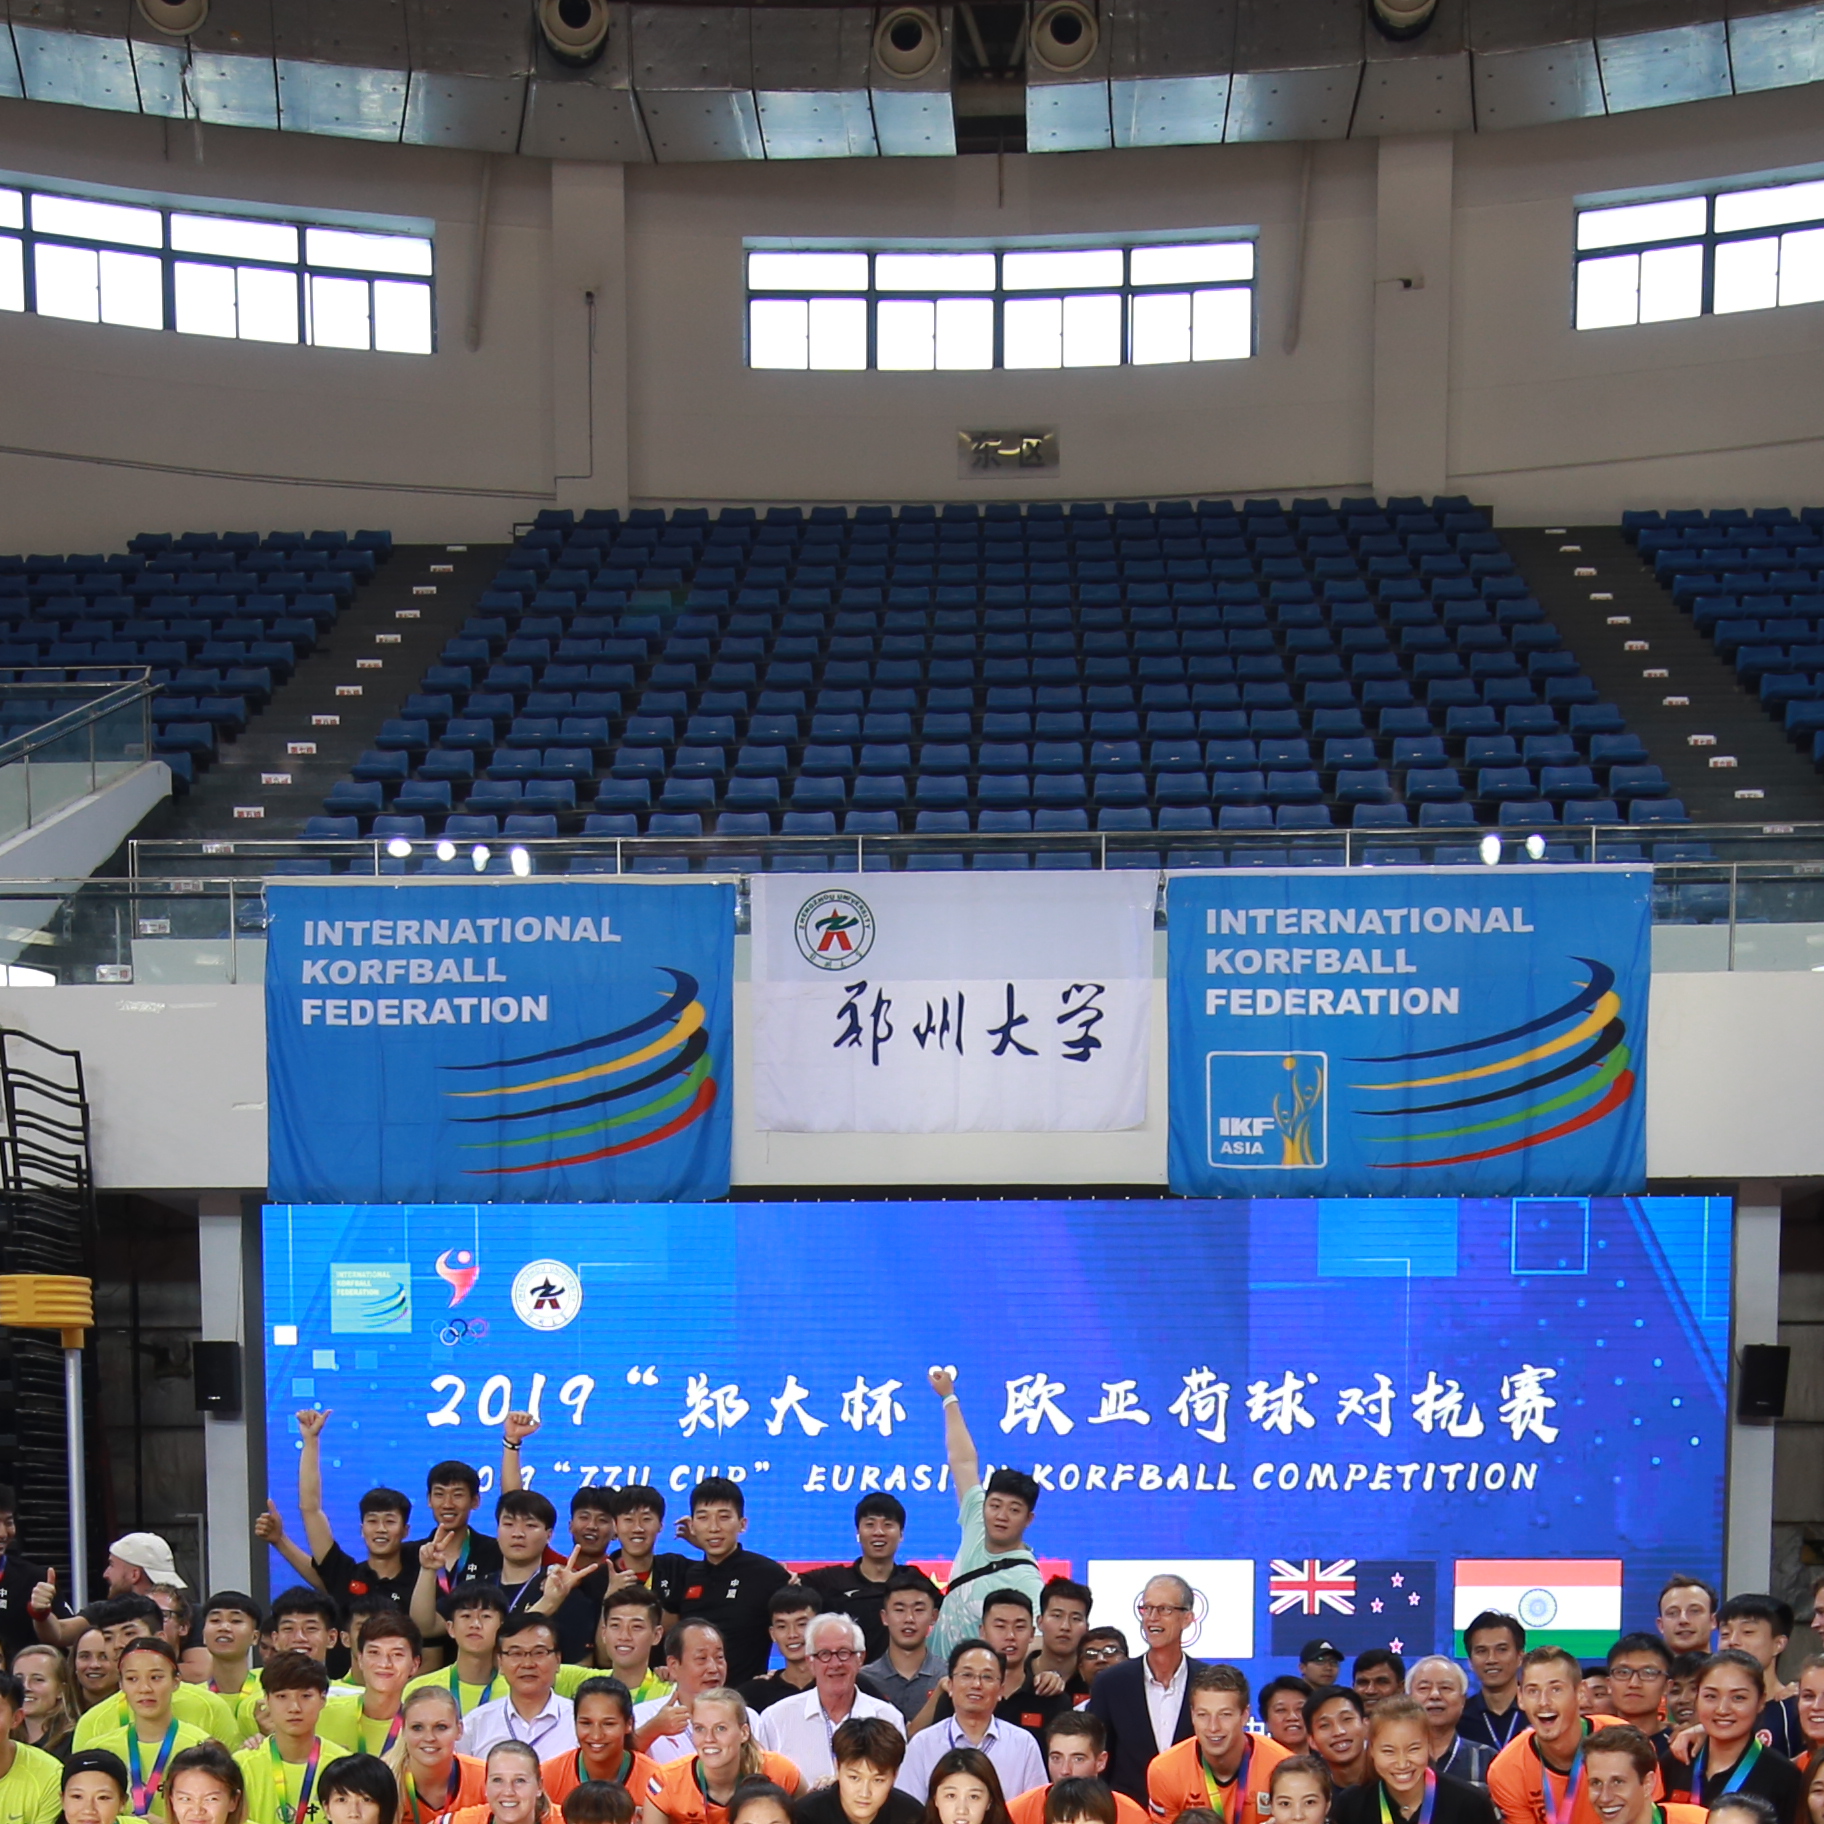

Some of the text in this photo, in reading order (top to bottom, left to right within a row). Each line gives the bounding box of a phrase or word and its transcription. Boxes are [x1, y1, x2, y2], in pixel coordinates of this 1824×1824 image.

[303, 916, 622, 947] INTERNATIONAL
[1206, 906, 1534, 934] INTERNATIONAL
[302, 956, 507, 985] KORFBALL
[1206, 948, 1417, 975] KORFBALL
[302, 995, 549, 1026] FEDERATION
[1206, 987, 1460, 1015] FEDERATION
[833, 980, 1106, 1066] 郑州大学
[1219, 1116, 1275, 1136] IKF
[1220, 1141, 1264, 1155] ASIA
[427, 1372, 596, 1428] 2019
[803, 1463, 1008, 1493] EURASI
[1032, 1463, 1236, 1493] KORFBALL
[1251, 1462, 1539, 1492] COMPETITION
